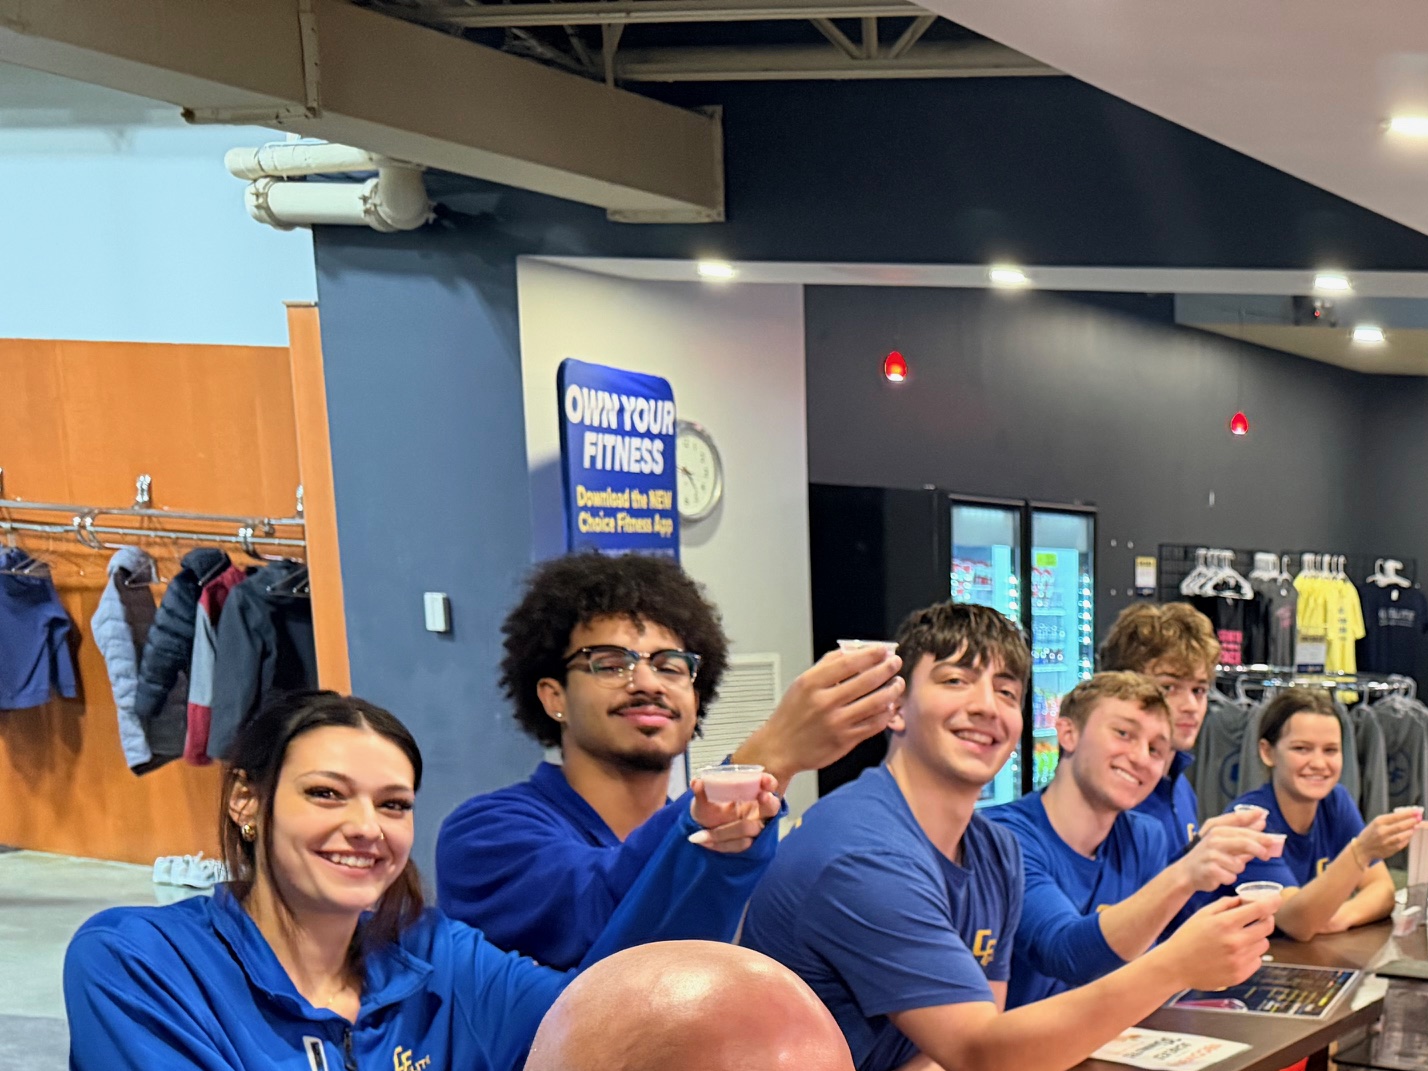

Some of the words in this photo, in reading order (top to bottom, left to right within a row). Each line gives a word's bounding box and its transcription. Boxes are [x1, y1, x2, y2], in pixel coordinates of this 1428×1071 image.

[565, 384, 620, 430] OWN
[620, 394, 675, 436] YOUR
[583, 431, 664, 475] FITNESS
[576, 485, 630, 510] Download
[631, 489, 648, 510] the
[649, 490, 673, 510] NEW
[578, 510, 616, 533] Choice
[617, 514, 653, 534] Fitness
[654, 515, 674, 538] App
